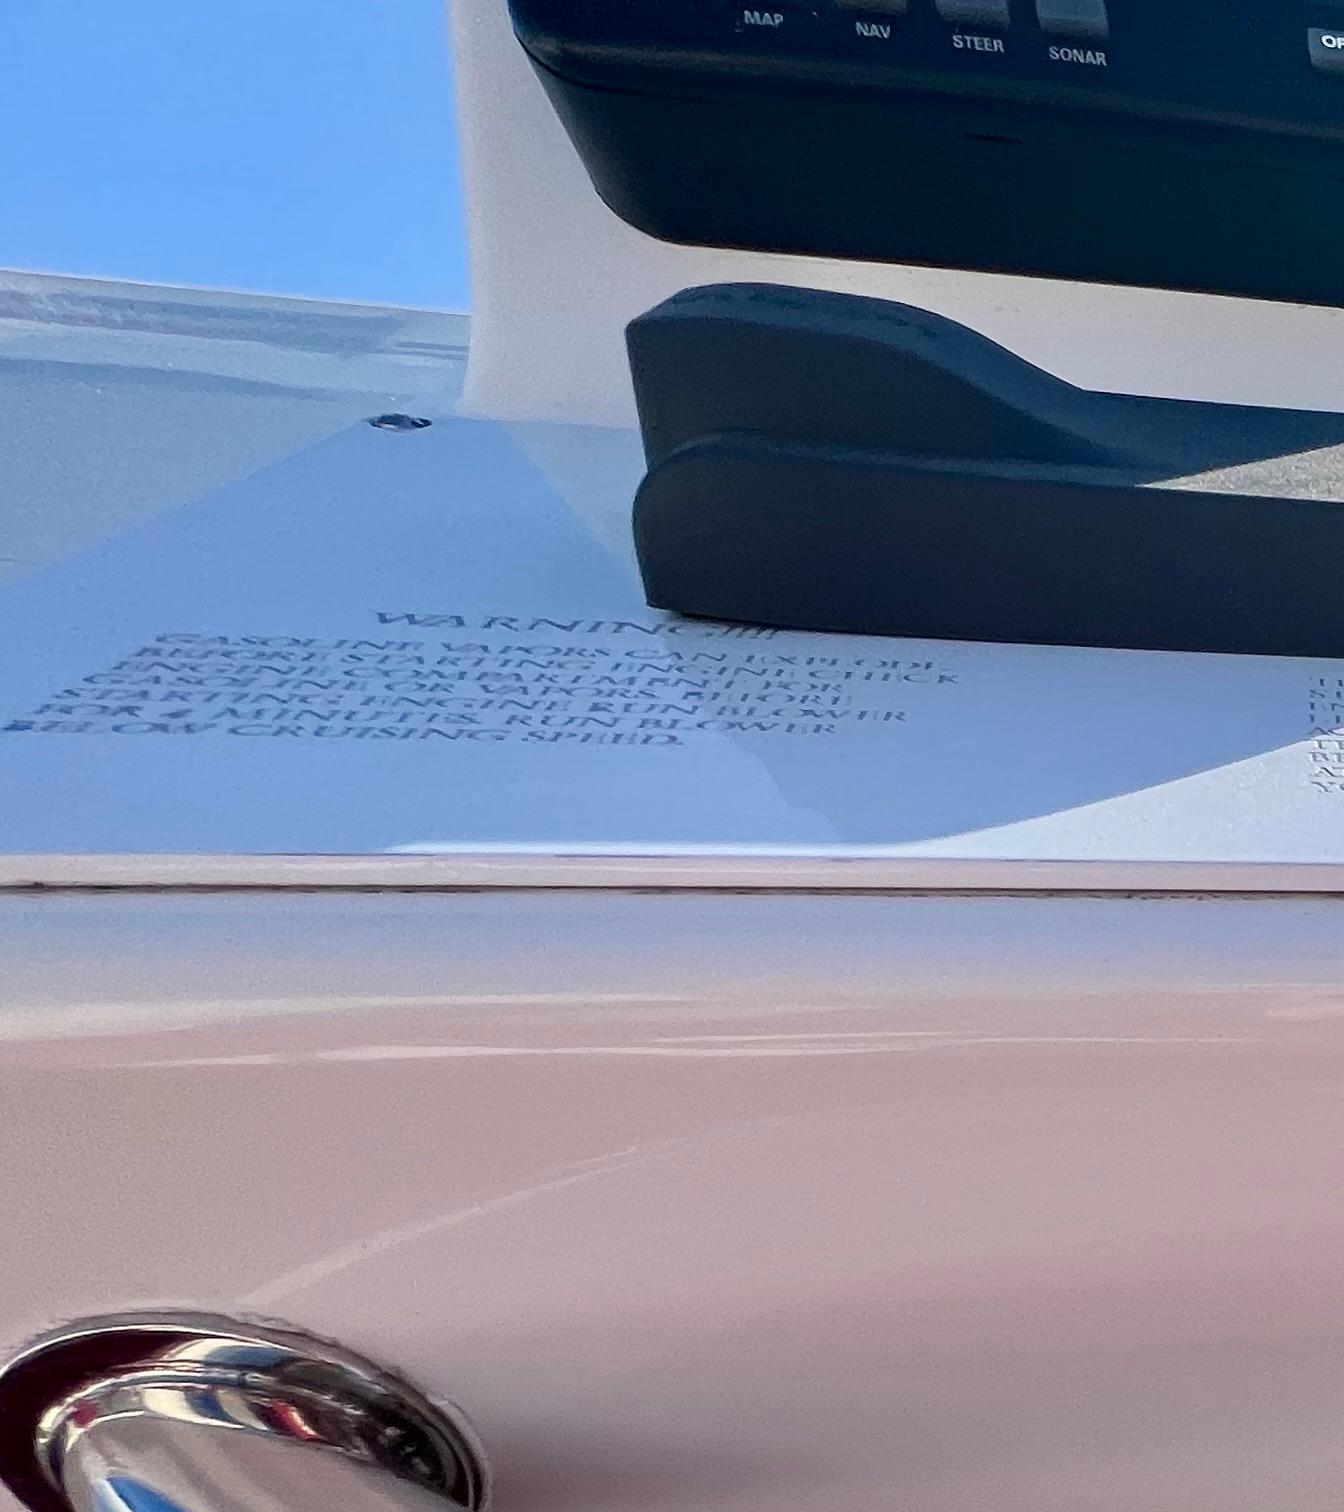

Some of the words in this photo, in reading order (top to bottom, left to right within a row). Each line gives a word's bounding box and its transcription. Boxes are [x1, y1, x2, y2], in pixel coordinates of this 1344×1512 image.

[743, 10, 783, 28] MAP
[855, 22, 891, 39] NAV
[952, 34, 1005, 53] STEER
[1047, 46, 1107, 67] SONAR
[155, 633, 424, 651] GASOLINE
[624, 650, 728, 662] CAN
[81, 673, 366, 691] GASOLINE
[383, 682, 455, 694] OR
[50, 688, 342, 706] STARTING
[588, 702, 700, 715] RUN
[504, 714, 621, 728] RUN
[638, 718, 838, 735] BLOWER
